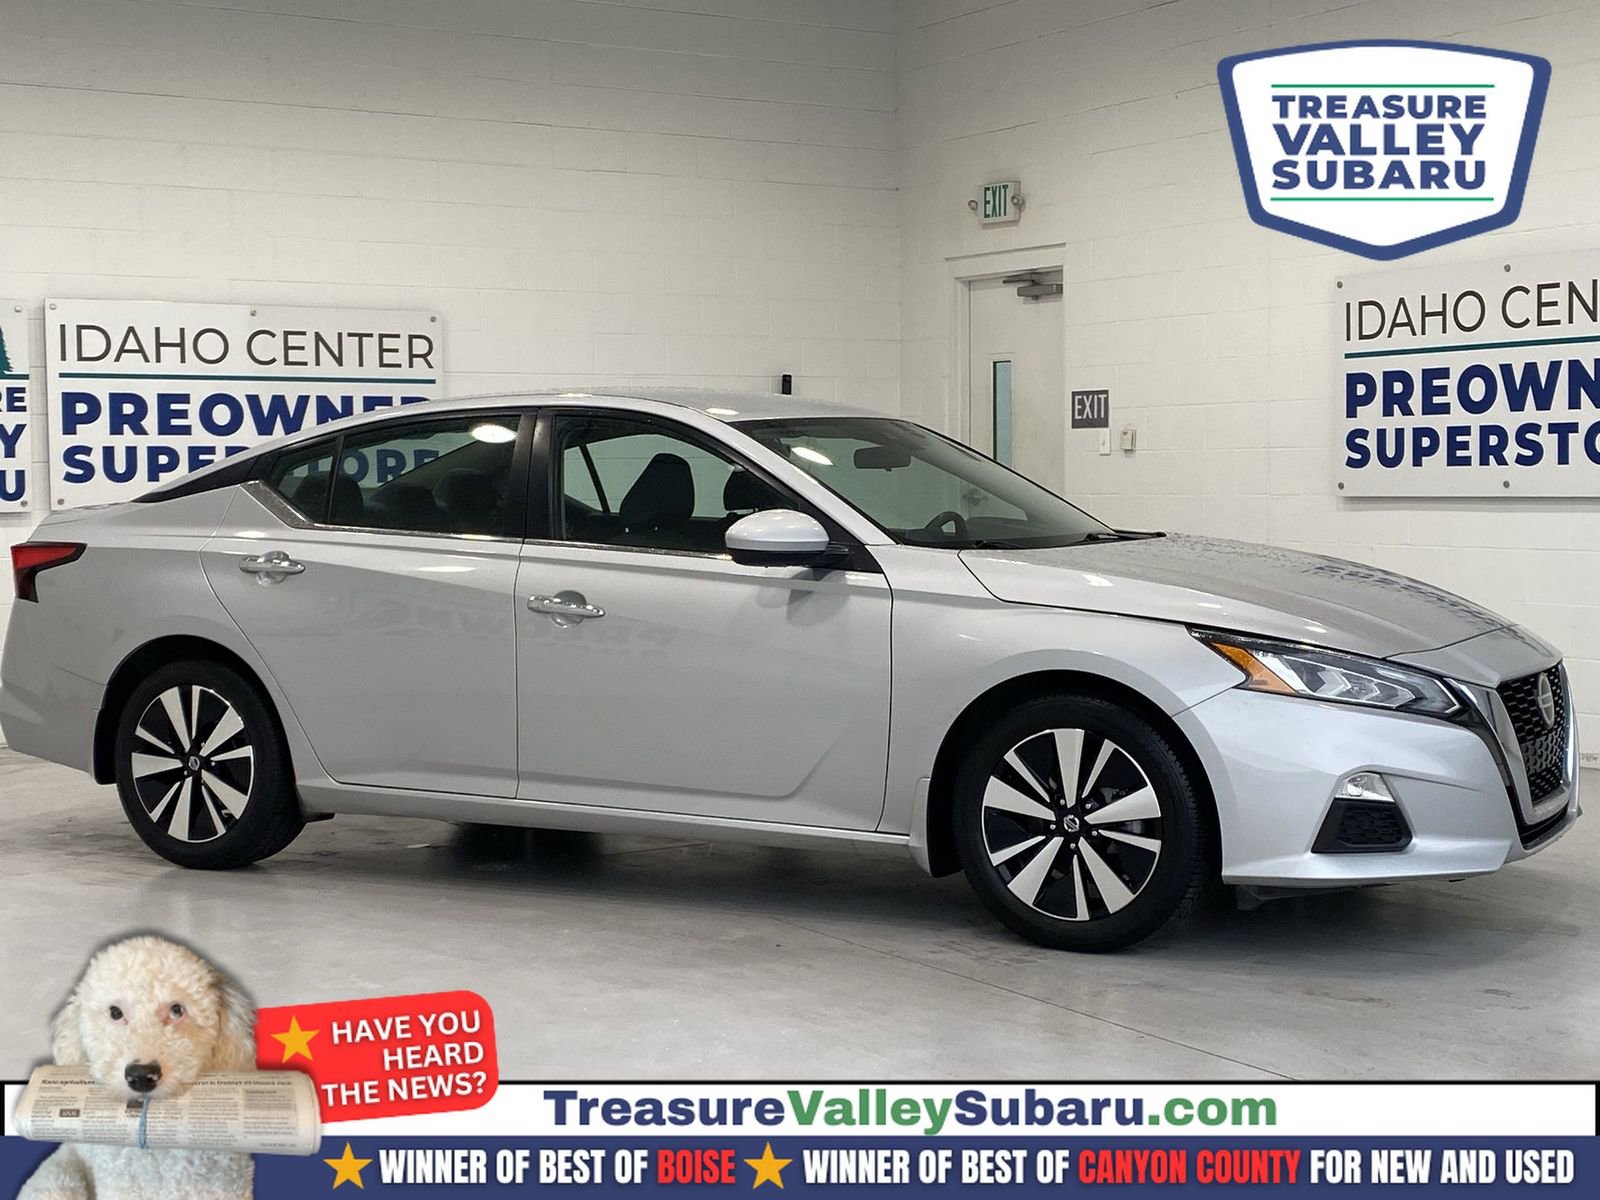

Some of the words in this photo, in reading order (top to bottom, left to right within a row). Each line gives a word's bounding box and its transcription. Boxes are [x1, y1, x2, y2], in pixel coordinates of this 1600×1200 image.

[984, 184, 1009, 218] EXIT
[1345, 290, 1486, 342] IDAHO
[1501, 278, 1599, 328] CEN
[59, 324, 229, 365] IDAHO
[247, 330, 435, 369] CENTER
[1074, 394, 1107, 420] EXIT
